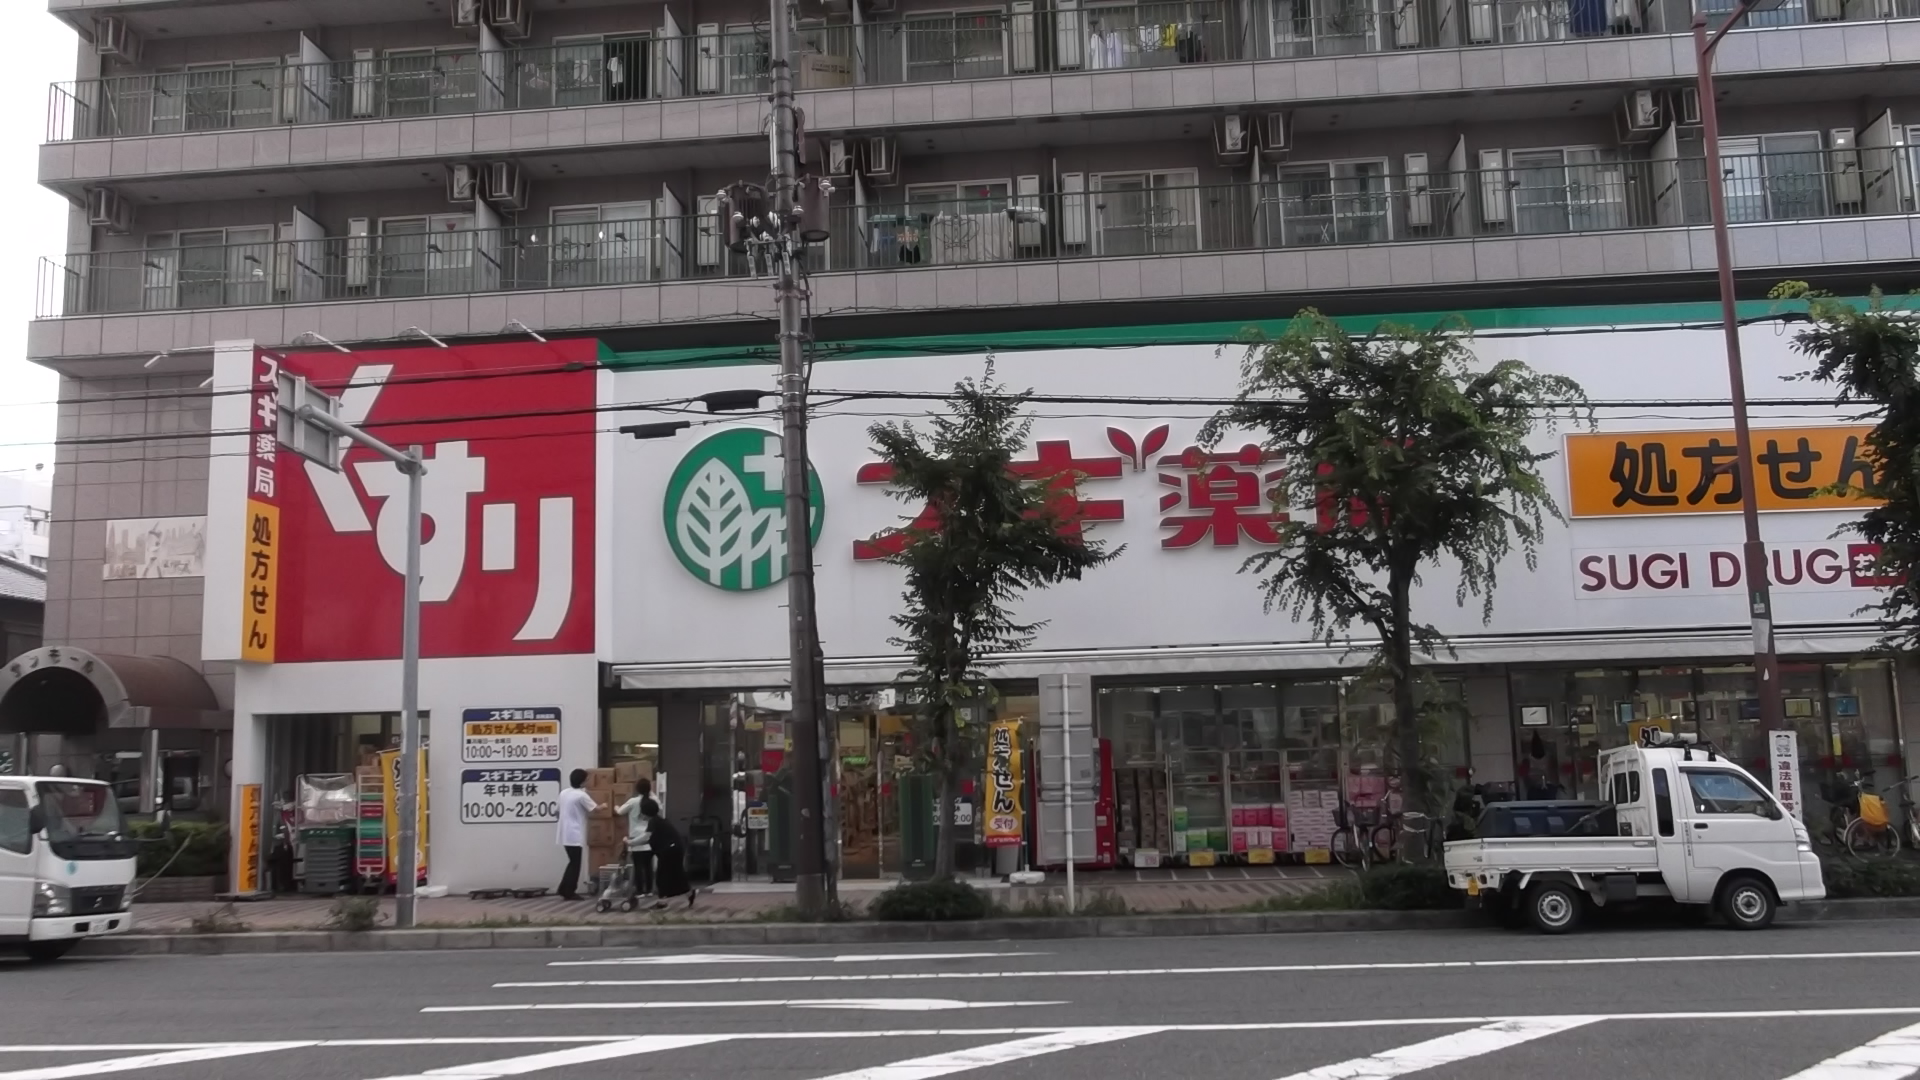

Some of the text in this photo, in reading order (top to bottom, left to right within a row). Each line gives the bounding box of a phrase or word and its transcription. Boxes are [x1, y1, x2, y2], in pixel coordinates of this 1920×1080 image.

[254, 355, 279, 498] スギ薬局
[304, 364, 574, 641] くすり
[249, 513, 271, 649] 処方せん
[1579, 548, 1843, 592] SUGI DUG
[479, 769, 543, 781] スギドラッグ
[483, 783, 538, 797] 年中無休
